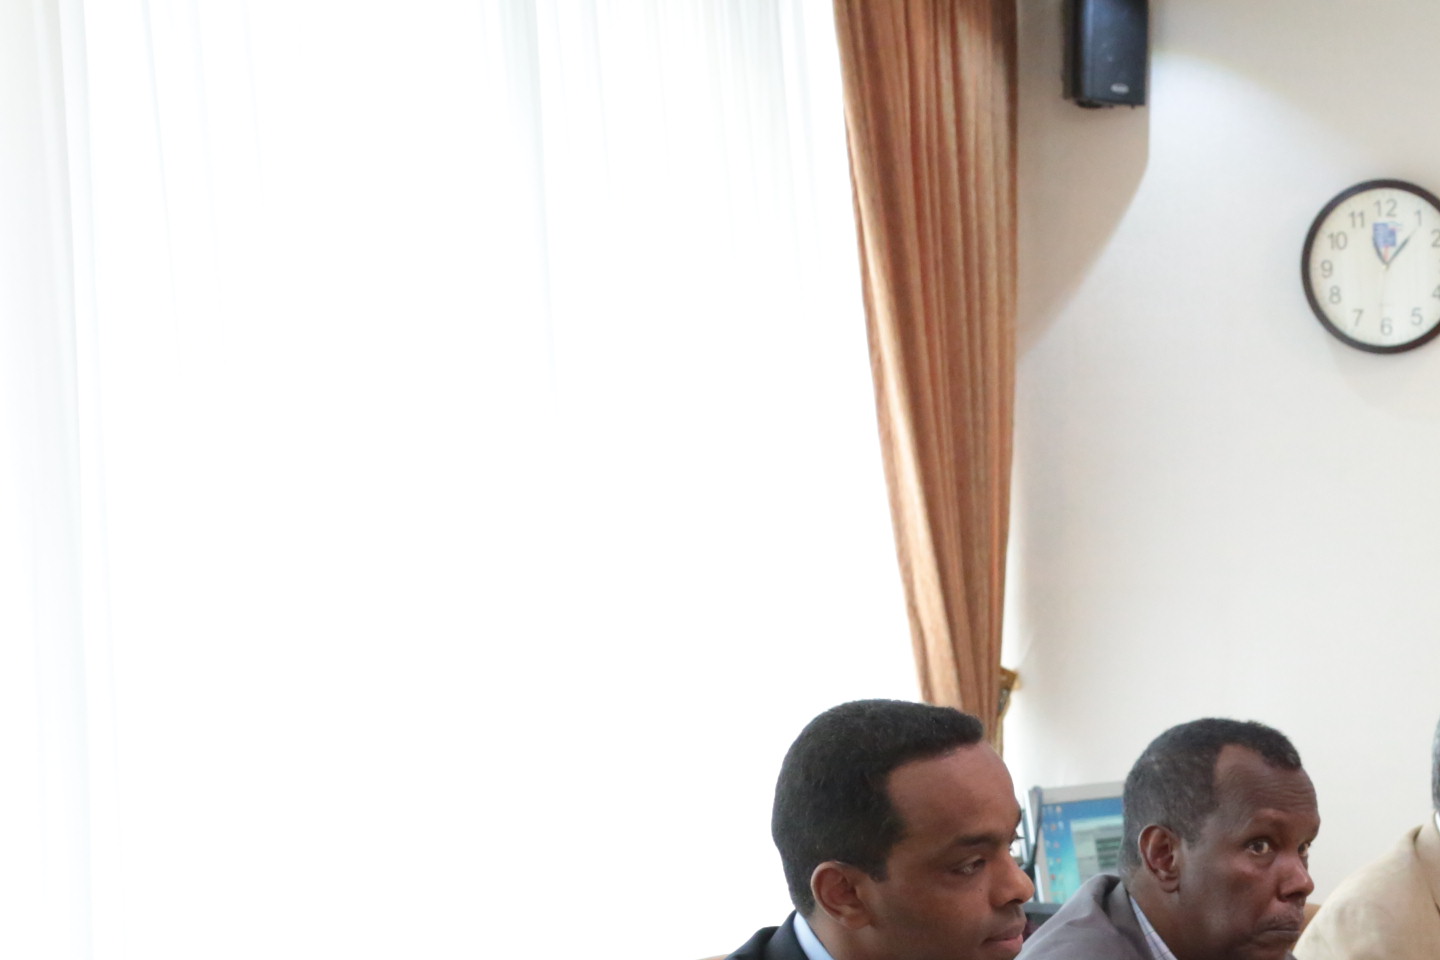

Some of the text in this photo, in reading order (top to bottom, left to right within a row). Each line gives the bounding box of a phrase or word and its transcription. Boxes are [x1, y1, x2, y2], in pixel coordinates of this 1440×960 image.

[1374, 199, 1397, 217] 12
[1350, 211, 1365, 228] 11
[1415, 210, 1422, 226] 1
[1329, 231, 1348, 250] 10
[1321, 260, 1333, 278] 9
[1330, 286, 1341, 304] 8
[1353, 309, 1364, 327] 7
[1411, 307, 1423, 326] 5
[1381, 318, 1393, 336] 6
